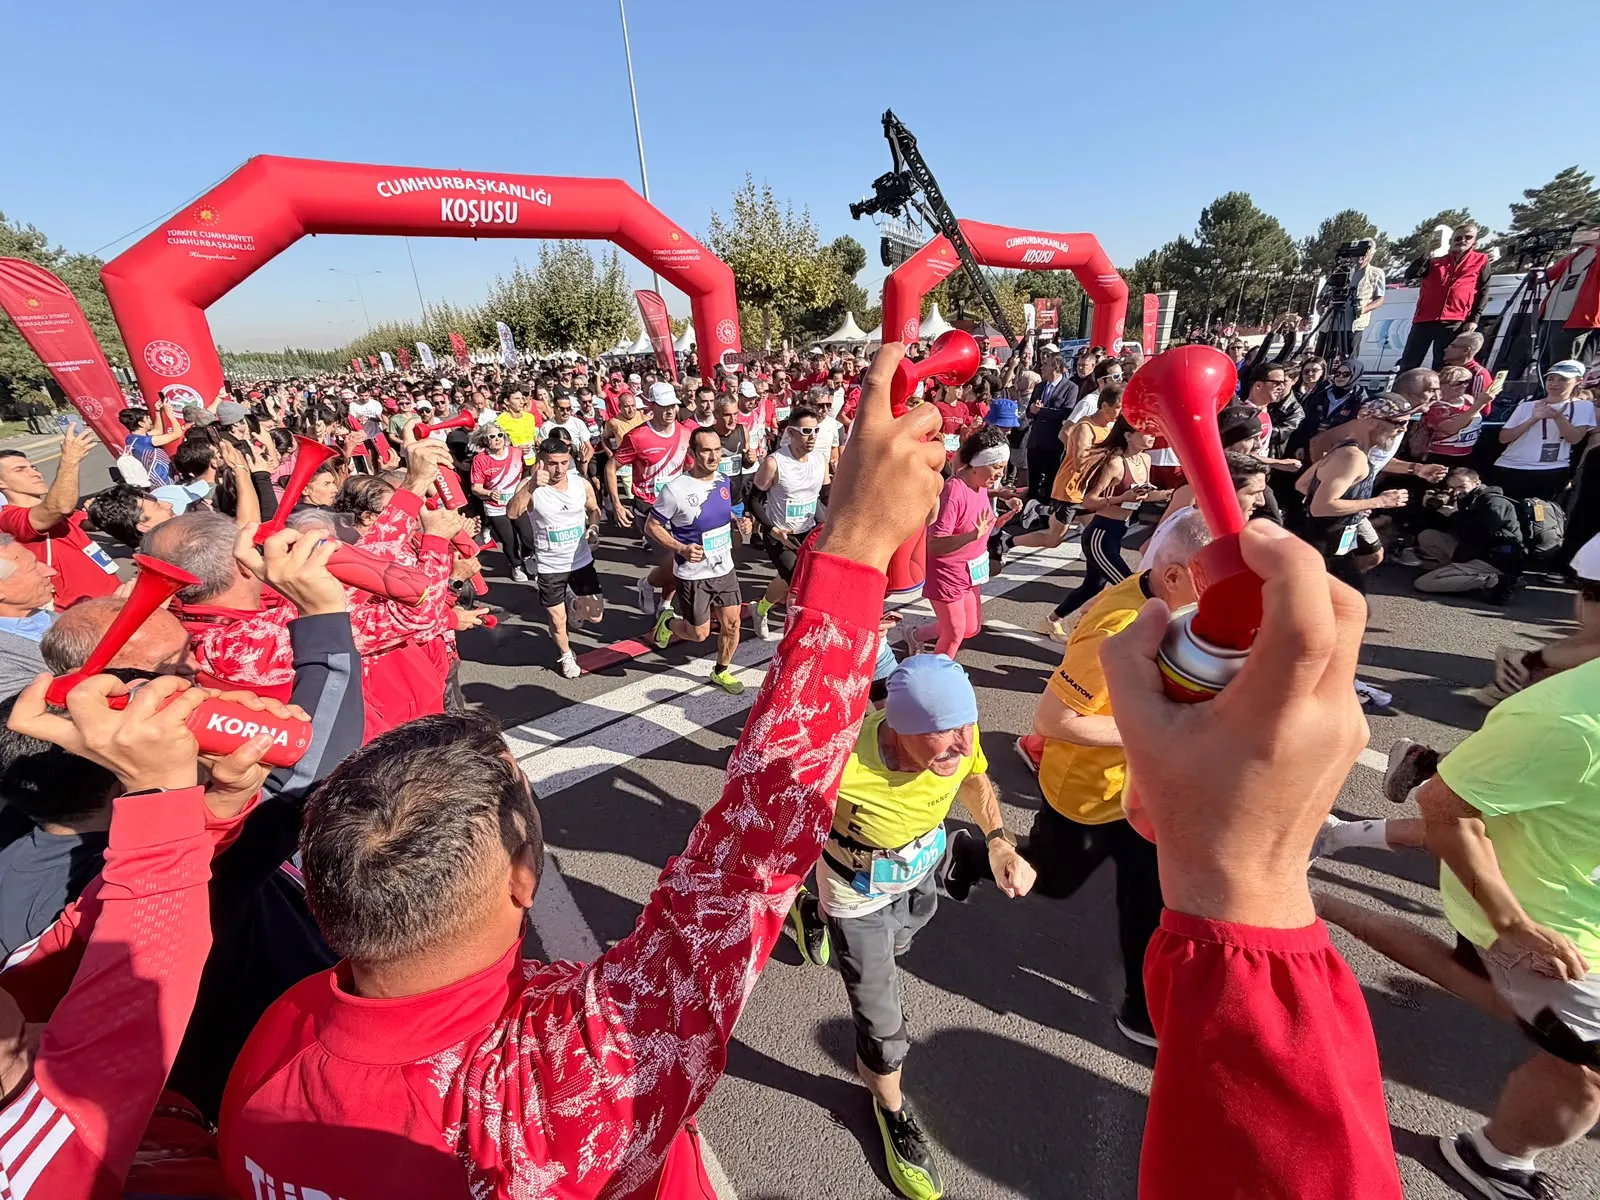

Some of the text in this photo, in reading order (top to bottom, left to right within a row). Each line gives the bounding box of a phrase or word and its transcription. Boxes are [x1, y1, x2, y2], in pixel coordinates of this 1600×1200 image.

[376, 176, 552, 207] CUMHURBAŞKANLIĞI
[441, 197, 519, 228] KOŞUSU
[167, 229, 254, 243] TÜRKİYE CUMHURİYETİ
[167, 238, 256, 251] CUMHURBAŞKANLIĞI
[1021, 249, 1056, 266] KOŞUSU
